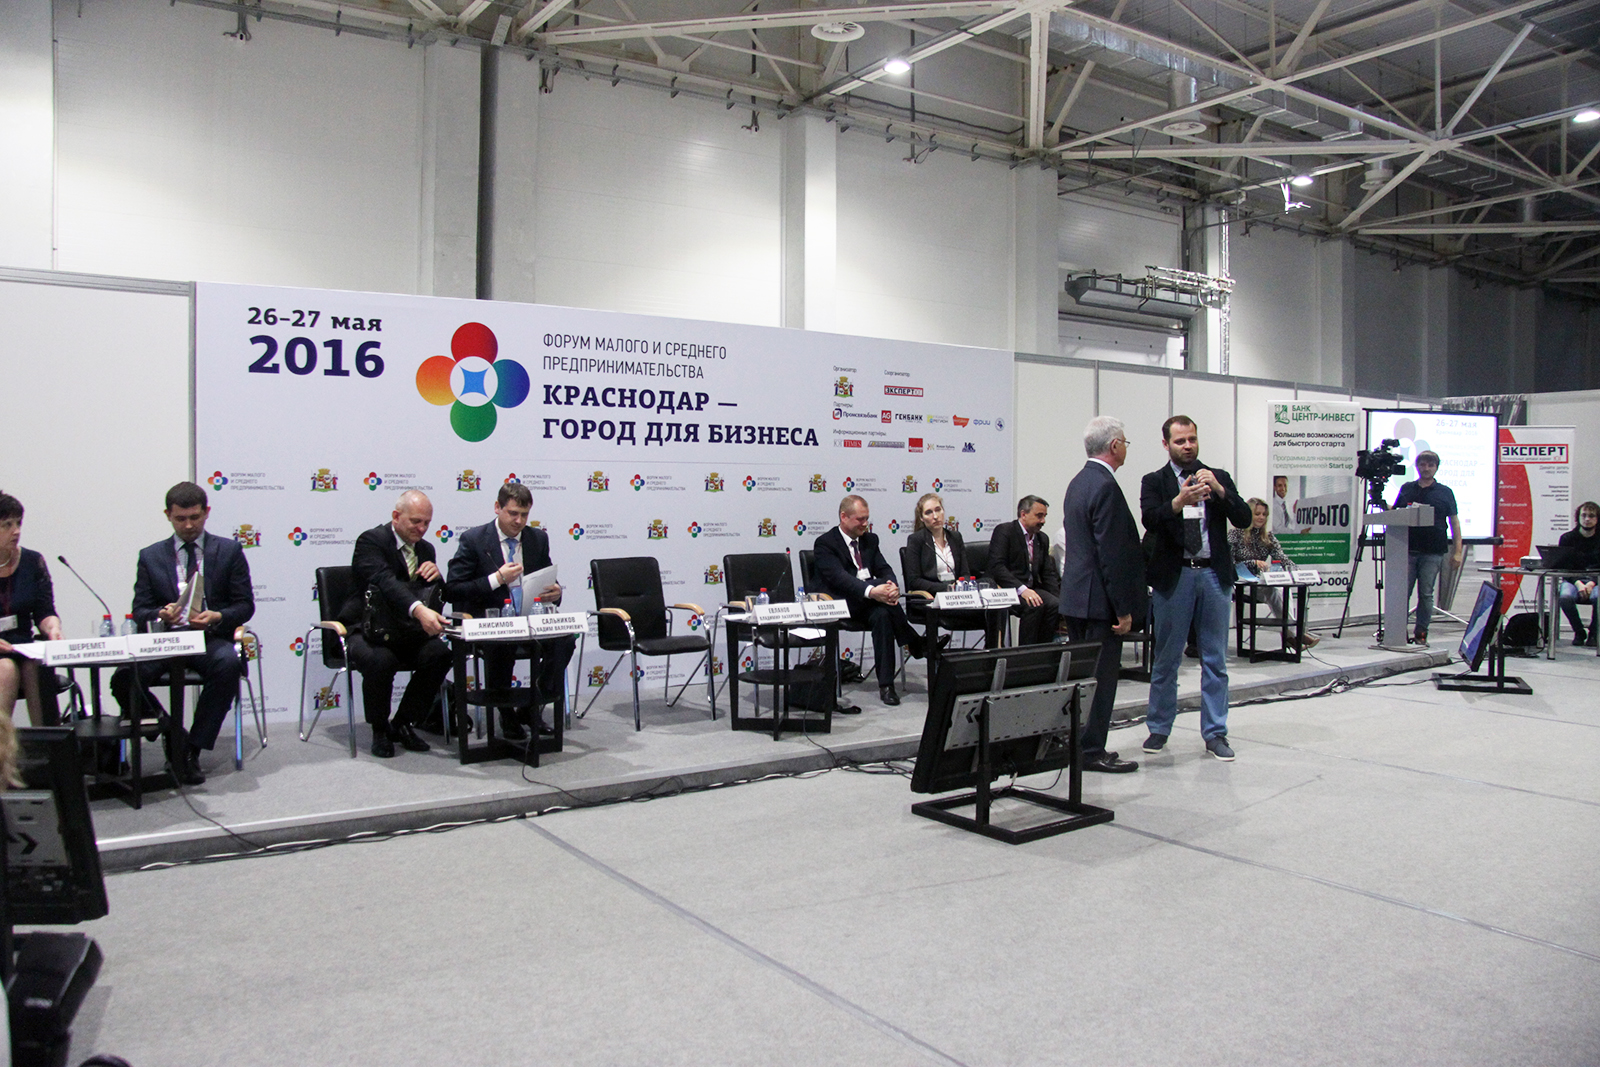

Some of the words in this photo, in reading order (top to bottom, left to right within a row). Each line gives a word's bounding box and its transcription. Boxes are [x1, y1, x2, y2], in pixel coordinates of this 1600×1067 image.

[248, 307, 321, 328] 26–27
[331, 316, 382, 332] мая
[248, 335, 385, 378] 2016
[543, 333, 591, 350] ФОРУМ
[595, 337, 649, 354] МАЛОГО
[653, 341, 661, 354] И
[665, 342, 727, 360] СРЕДНЕГО
[543, 355, 704, 379] ПРЕДПРИНИМАТЕЛЬСТВА
[543, 384, 710, 414] КРАСНОДАР
[894, 413, 923, 421] ГЕНБАНК
[1292, 412, 1355, 422] ЦЕНТР-ИНВЕСТ
[543, 418, 636, 446] ГОРОД
[644, 422, 700, 446] ДЛЯ
[708, 424, 819, 446] БИЗНЕСА
[1288, 440, 1320, 448] быстрого
[1502, 446, 1565, 456] ЭКСПЕРТ
[1440, 459, 1478, 467] РАСНОДАР
[1296, 504, 1350, 527] ОТКРЫТО
[69, 642, 106, 651] ШЕРЕМЕТ
